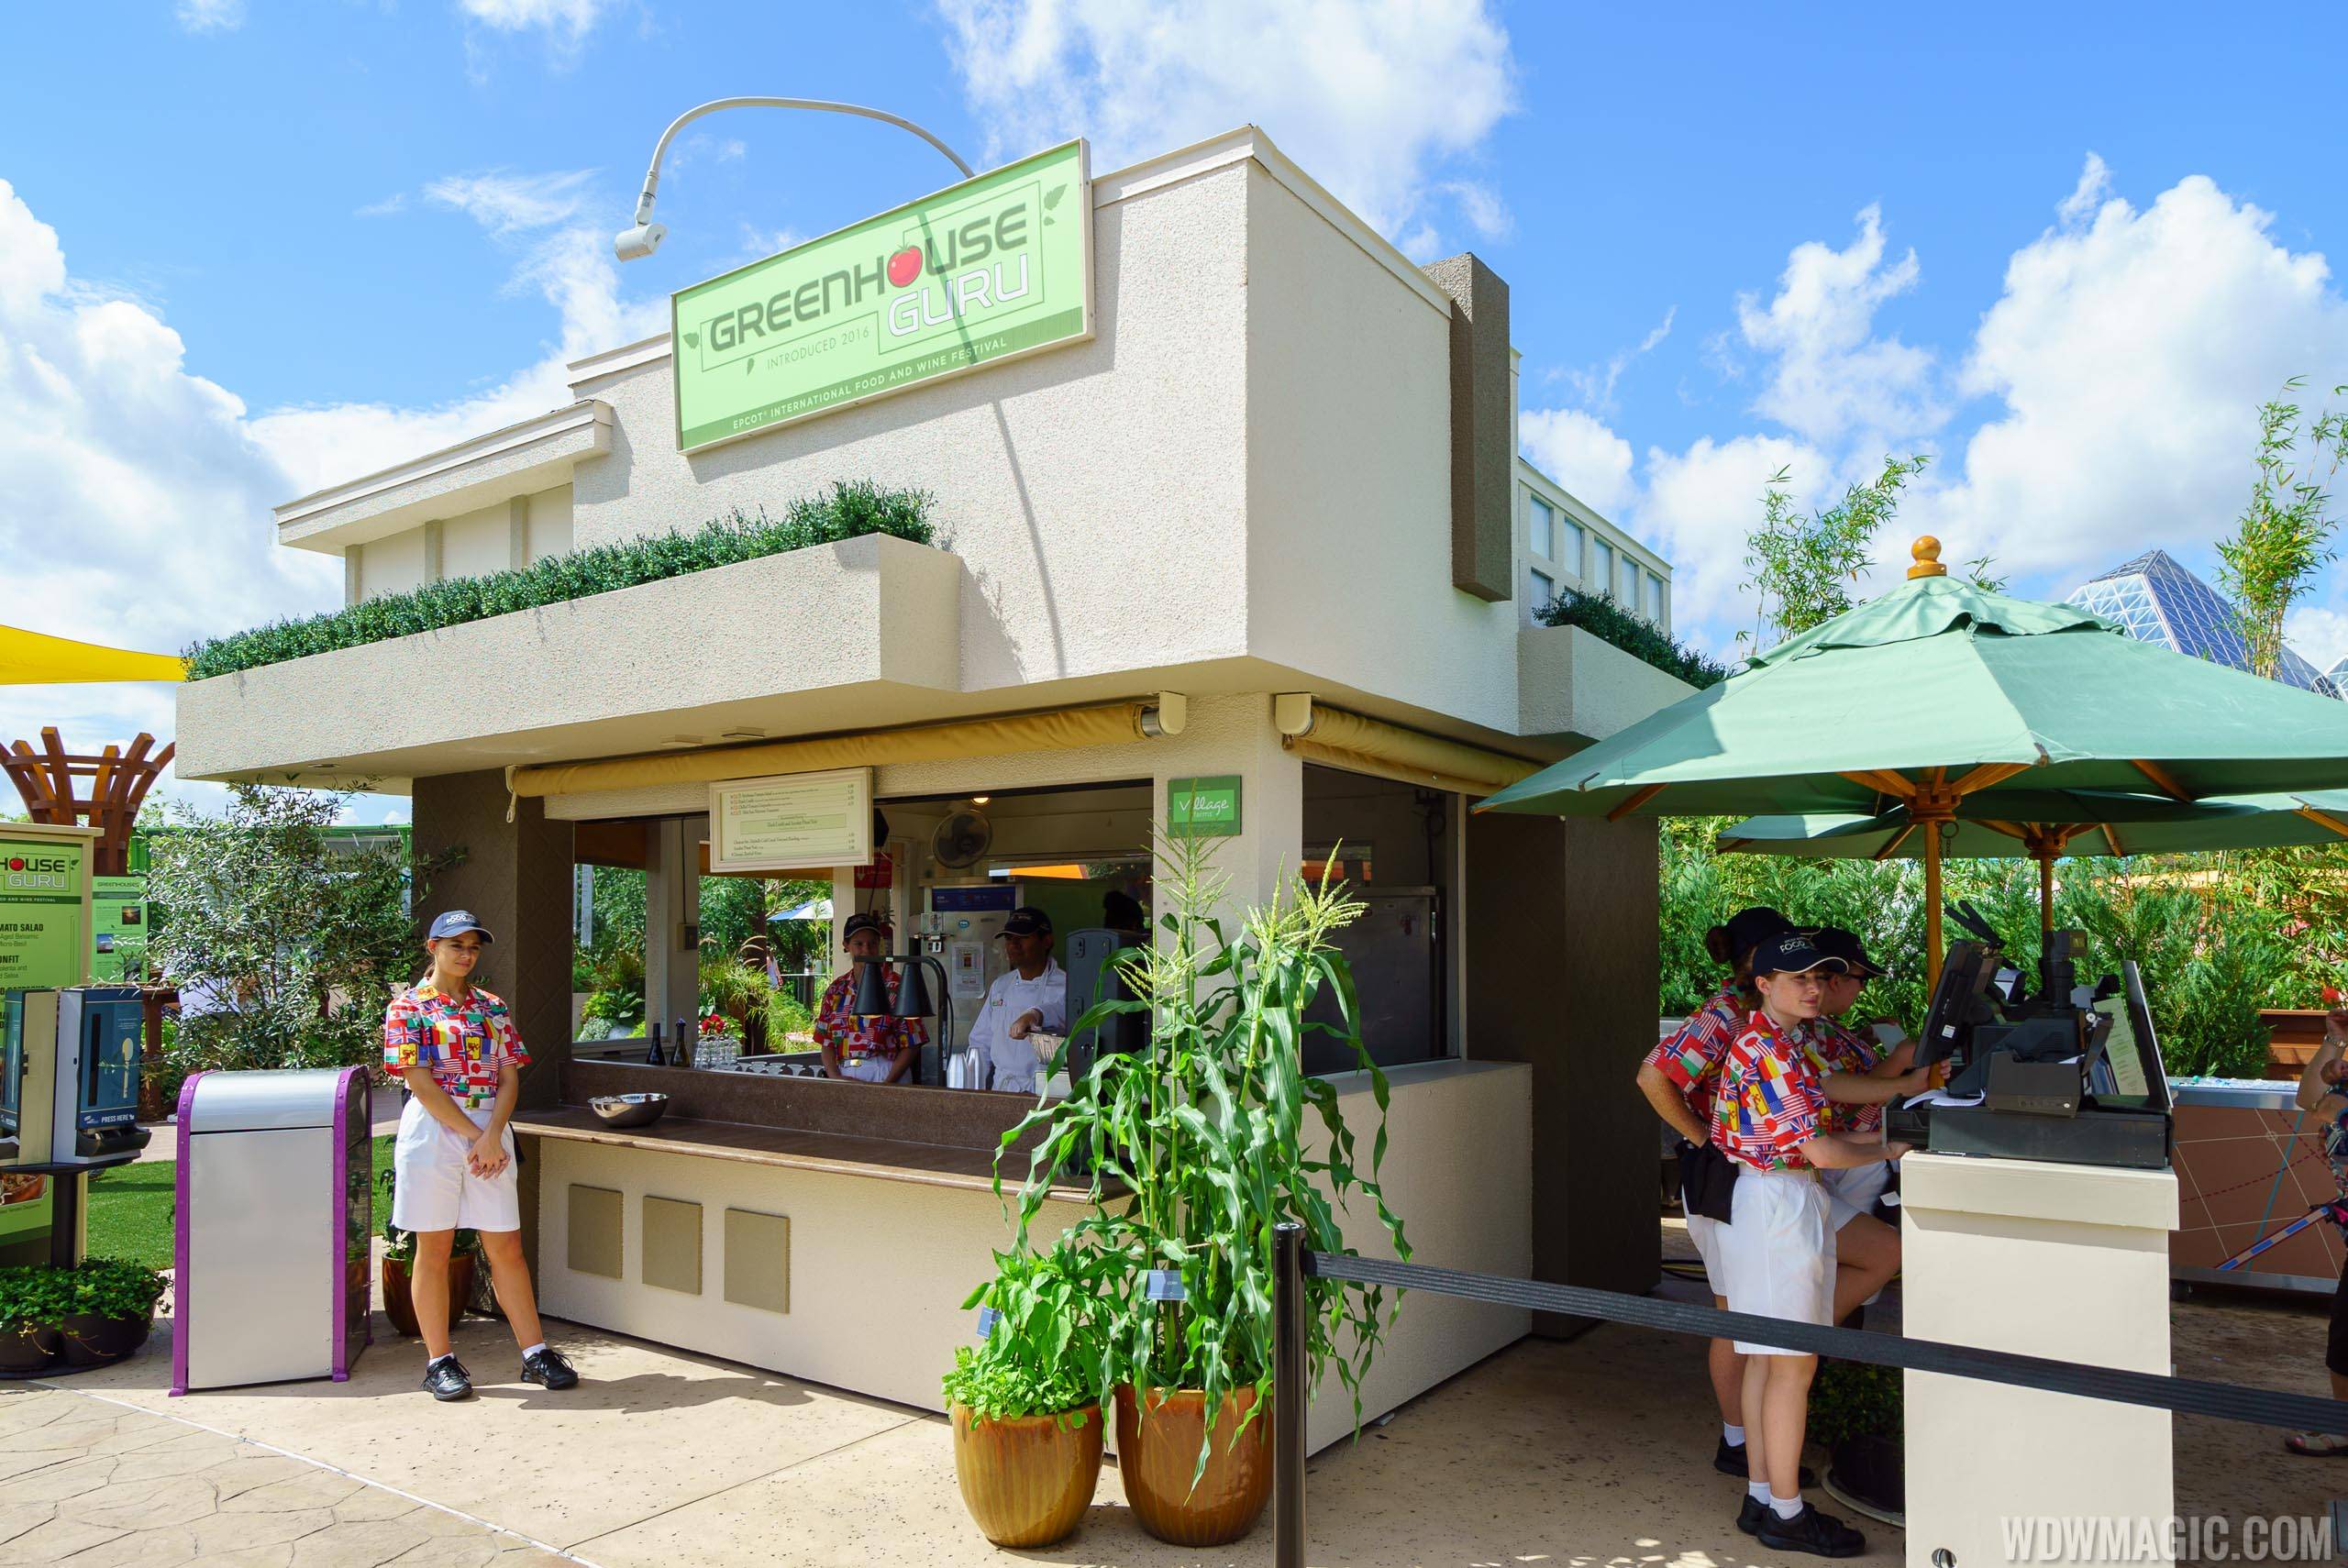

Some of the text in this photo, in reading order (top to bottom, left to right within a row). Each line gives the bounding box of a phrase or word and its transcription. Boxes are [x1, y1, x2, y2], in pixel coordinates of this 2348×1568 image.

[710, 202, 1027, 352] GREENHOUSE
[887, 253, 1029, 337] GURU
[767, 325, 869, 370] INTRODUCED 2016
[770, 386, 851, 417] INTERNATIONAL
[855, 374, 885, 392] FOOD
[889, 367, 913, 381] AND
[916, 357, 947, 372] WINE
[951, 337, 1007, 362] FESTIVAL
[1180, 796, 1229, 816] Vllage
[8, 873, 65, 888] GURU
[20, 923, 44, 932] SALAD
[1779, 940, 1806, 954] FOOD
